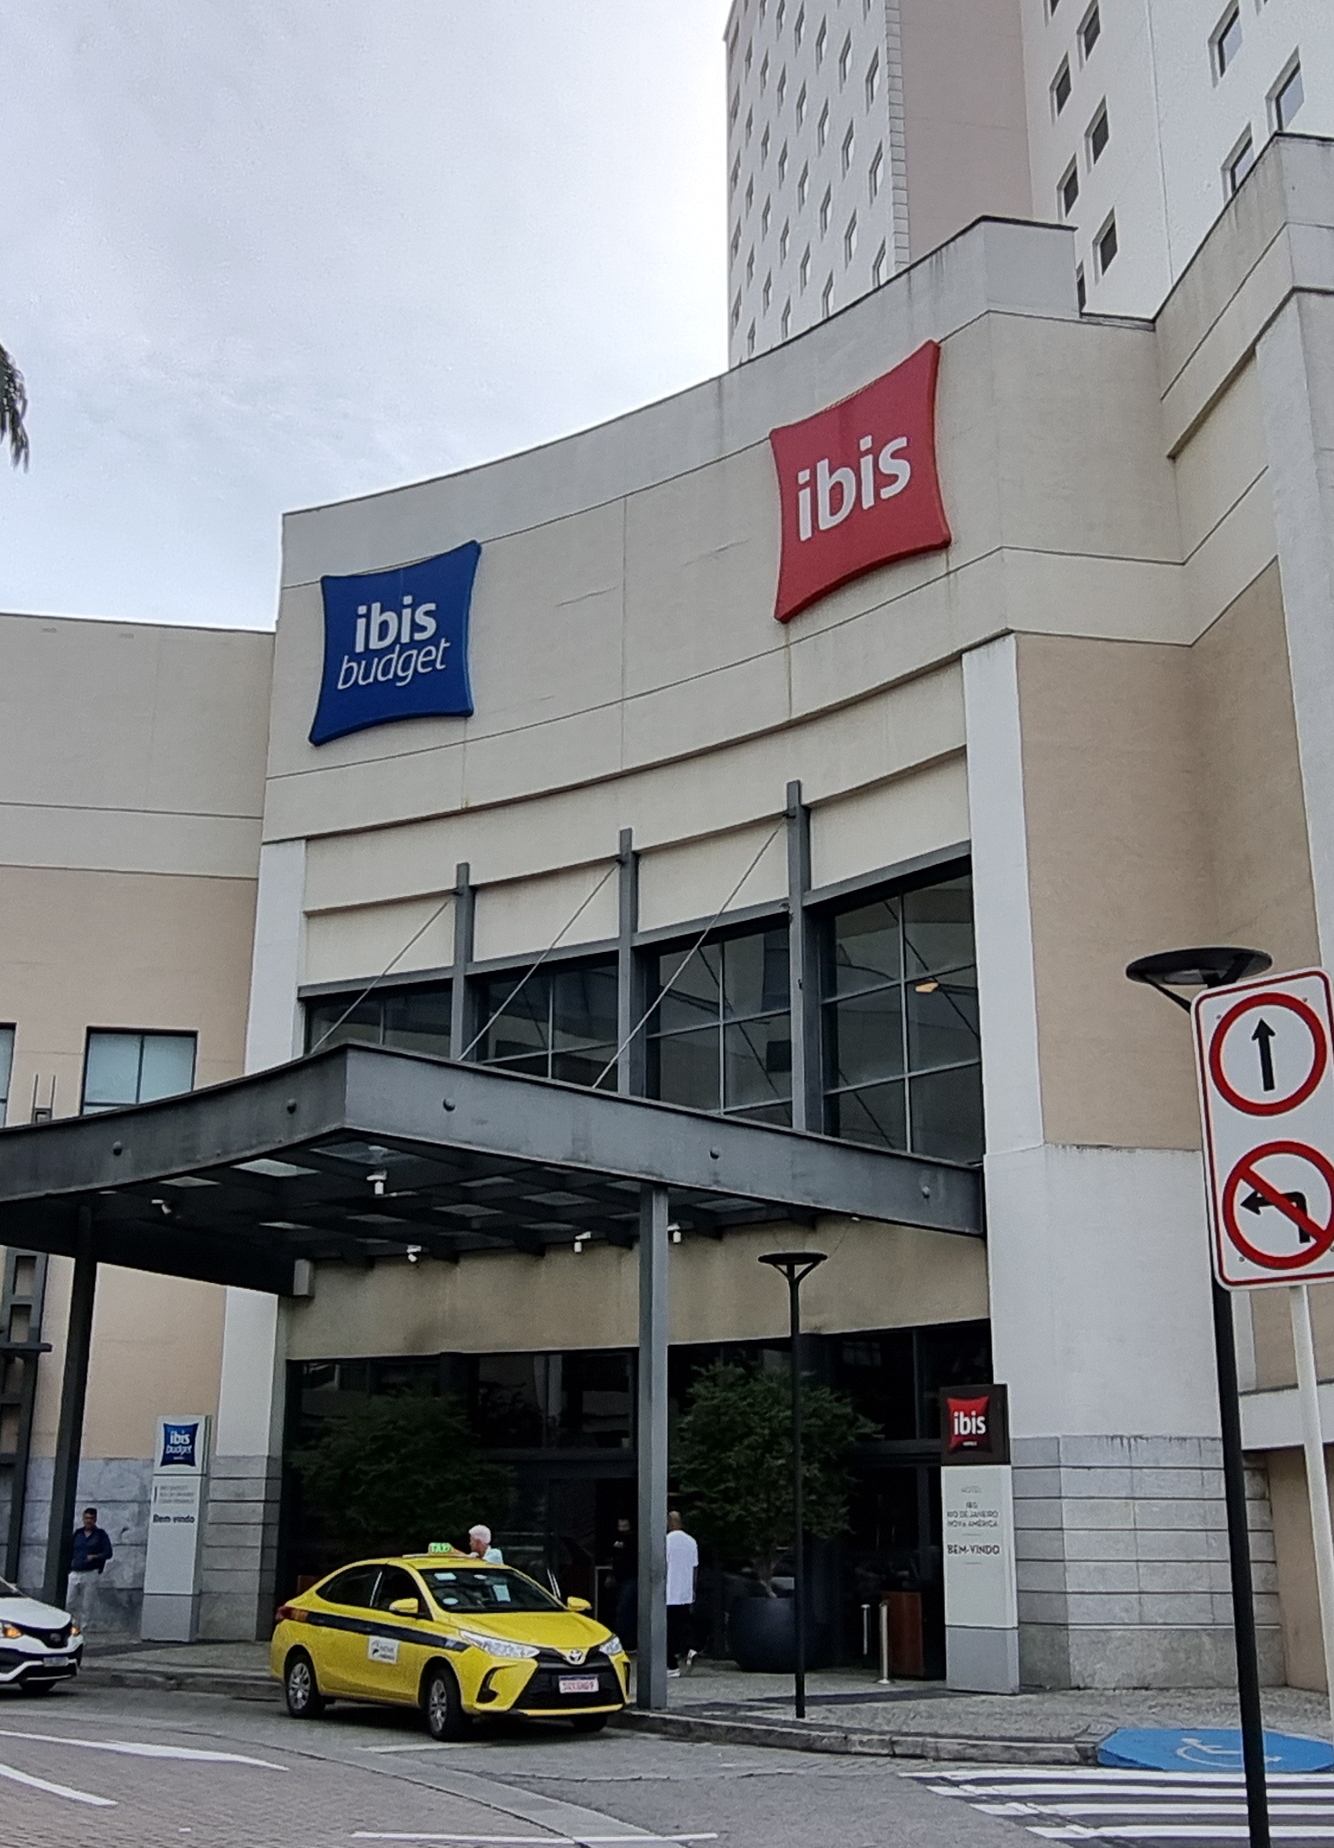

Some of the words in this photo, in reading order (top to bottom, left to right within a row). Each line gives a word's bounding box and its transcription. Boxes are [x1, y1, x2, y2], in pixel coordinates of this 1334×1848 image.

[797, 434, 912, 542] ibis
[354, 594, 437, 653] ibis
[336, 637, 451, 690] budget
[170, 1430, 191, 1445] ibis
[953, 1410, 987, 1436] ibis
[947, 1544, 1001, 1555] BEM-VINDO
